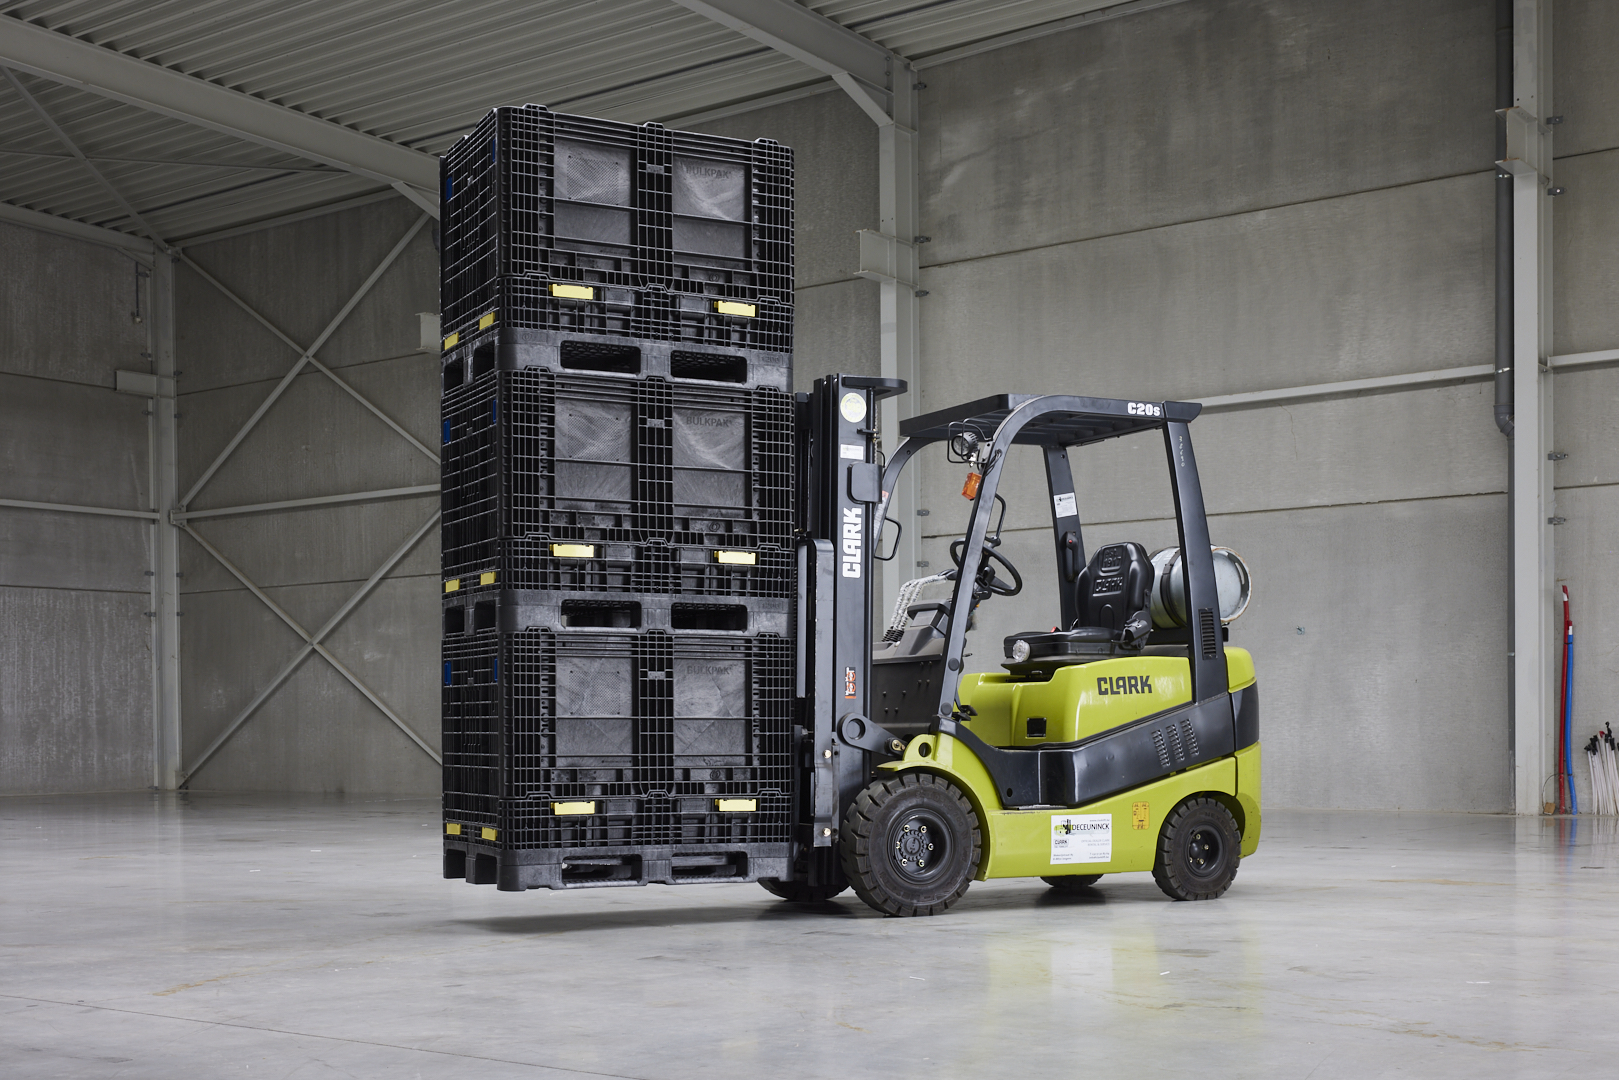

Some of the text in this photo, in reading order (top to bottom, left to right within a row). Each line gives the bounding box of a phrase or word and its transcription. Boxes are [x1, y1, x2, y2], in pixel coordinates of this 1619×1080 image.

[1127, 402, 1160, 416] C20s
[843, 507, 862, 578] CLARK
[1094, 576, 1123, 592] CLARK
[1097, 675, 1152, 695] CLARK
[1072, 823, 1110, 831] DECEUNINCK
